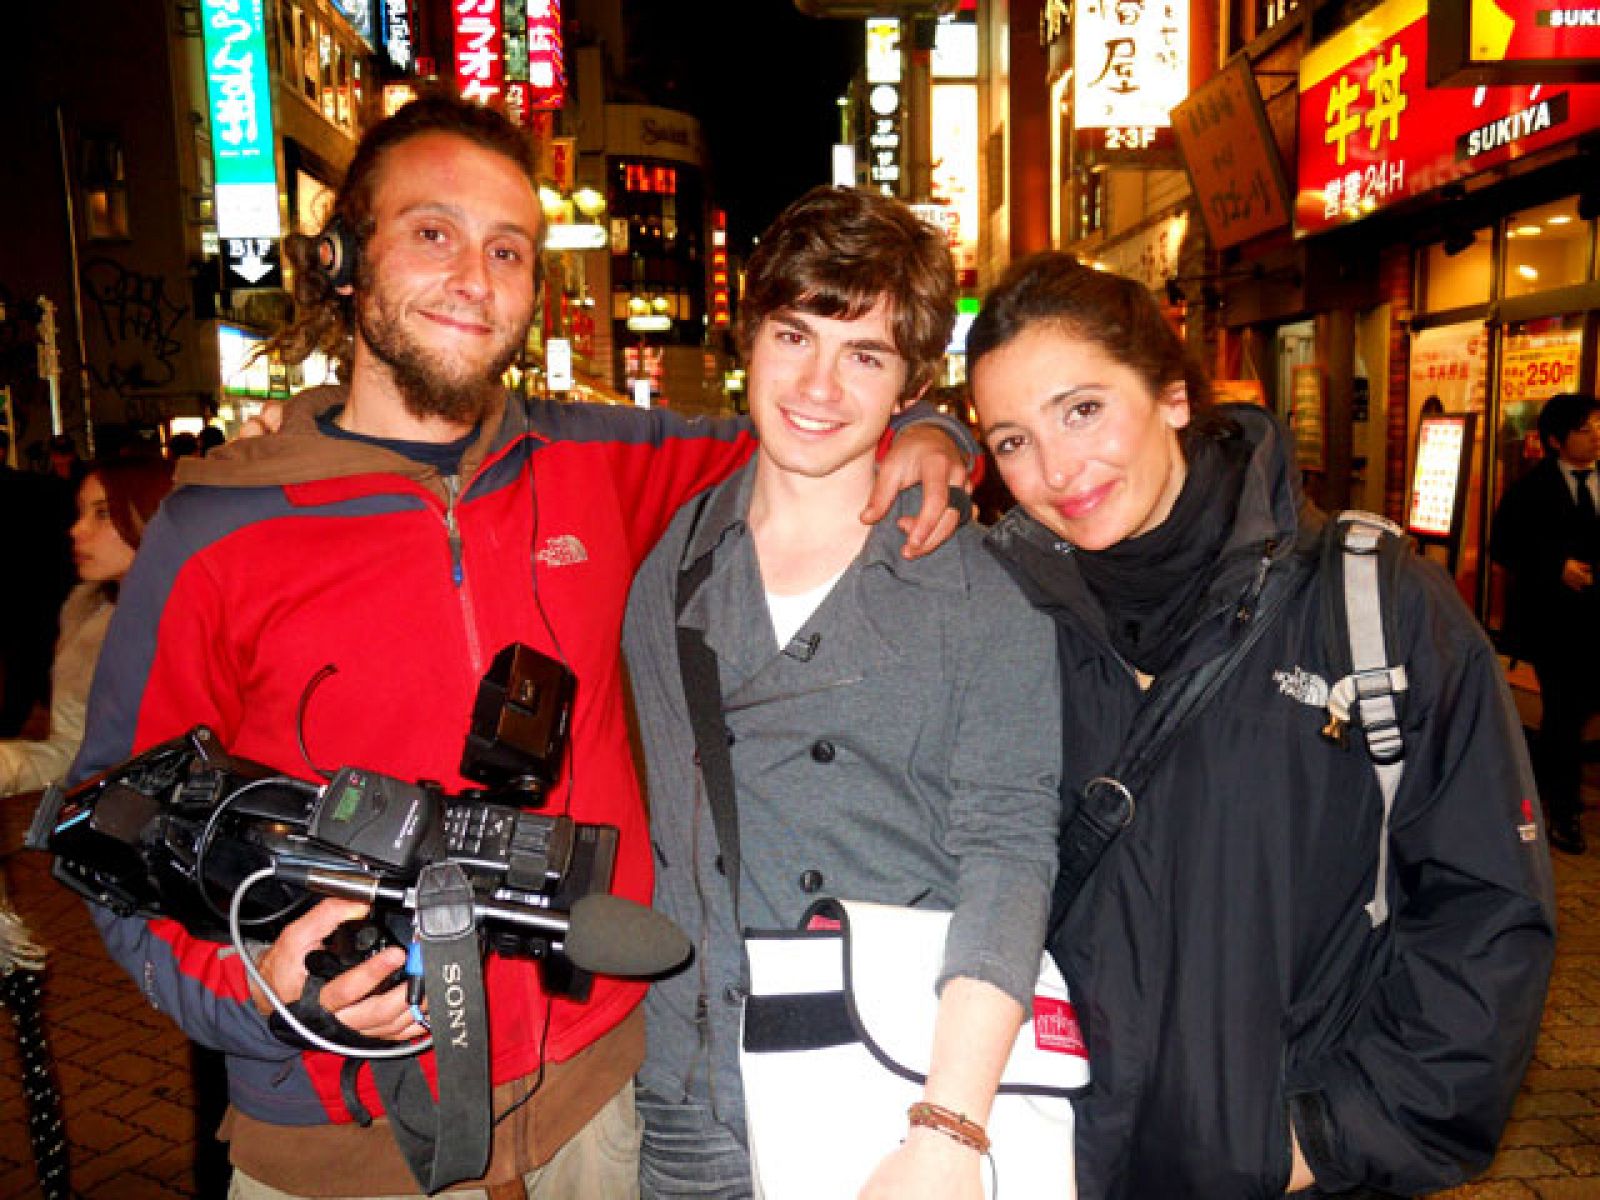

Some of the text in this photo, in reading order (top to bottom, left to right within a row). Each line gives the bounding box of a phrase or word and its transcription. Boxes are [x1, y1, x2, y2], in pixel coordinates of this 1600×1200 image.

[1324, 42, 1408, 167] 牛丼
[1467, 100, 1551, 157] SUKIYA
[443, 962, 468, 1049] SONY
